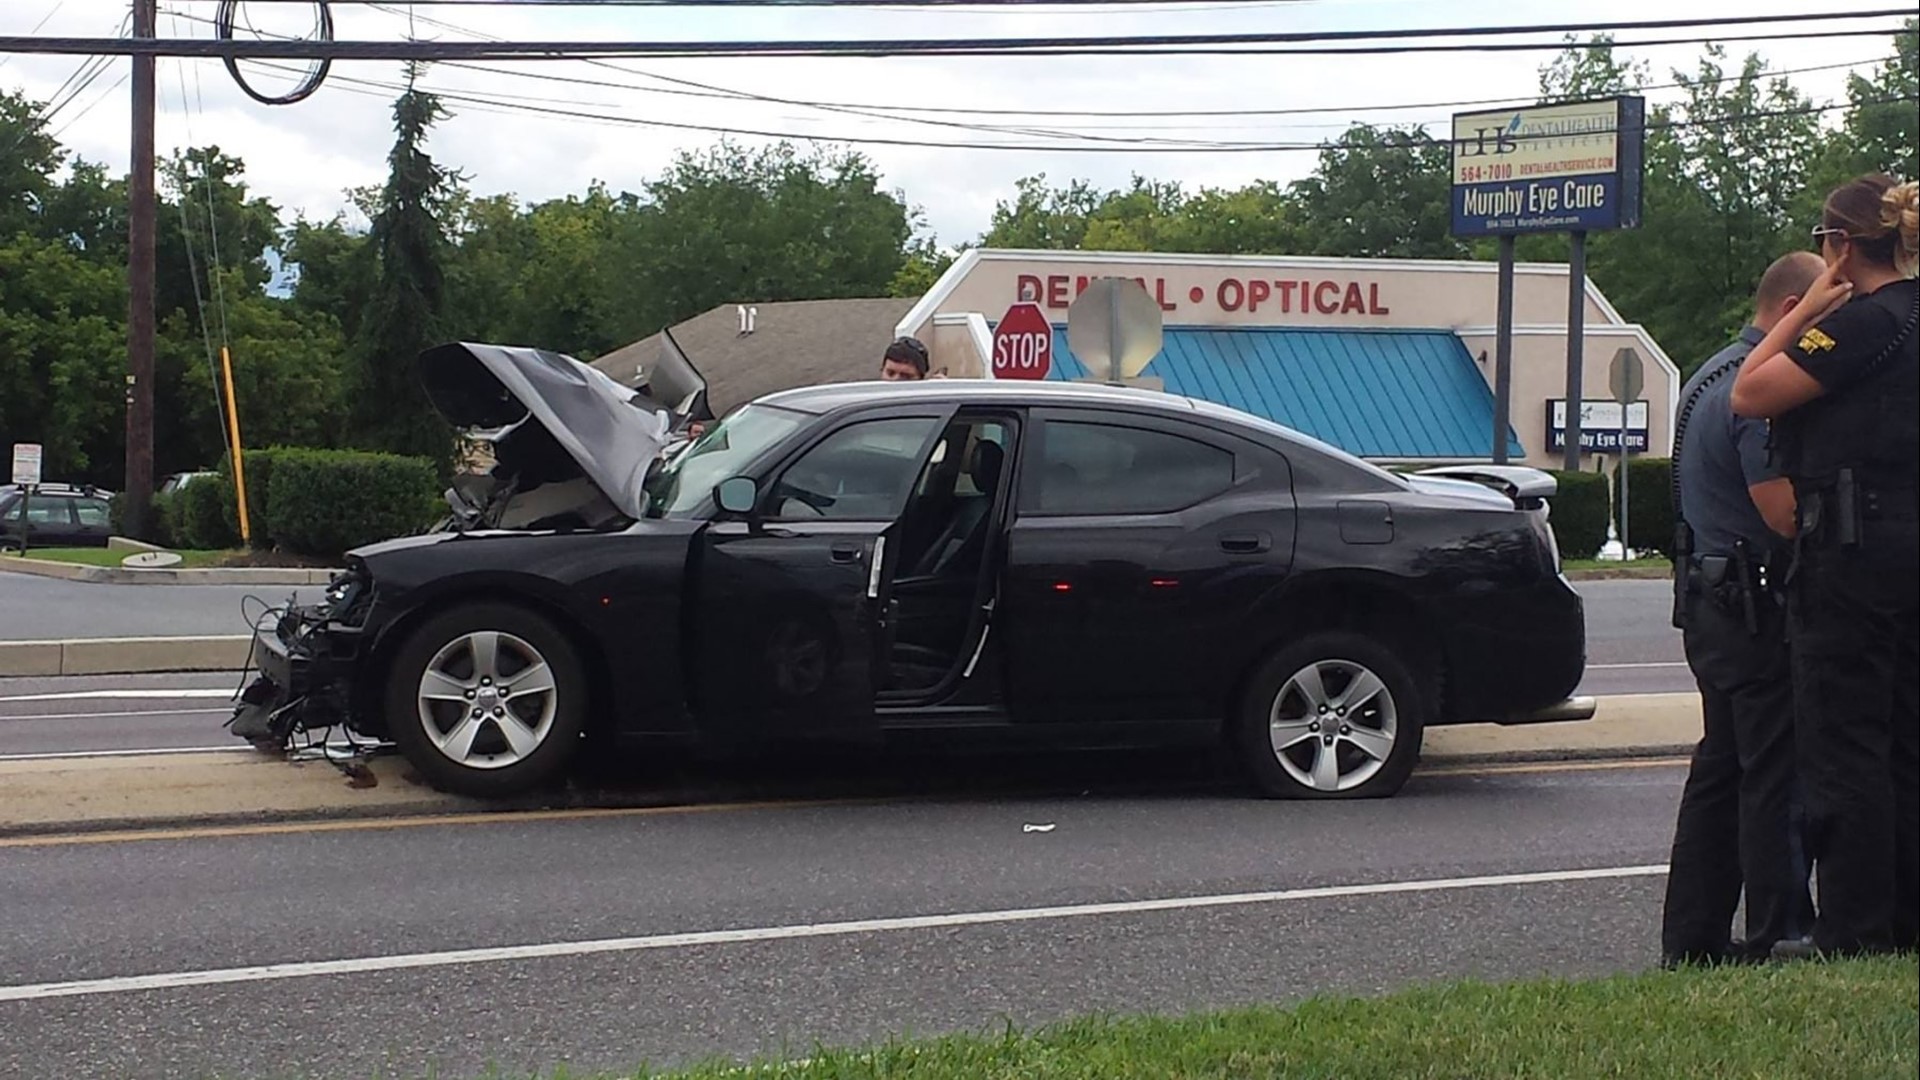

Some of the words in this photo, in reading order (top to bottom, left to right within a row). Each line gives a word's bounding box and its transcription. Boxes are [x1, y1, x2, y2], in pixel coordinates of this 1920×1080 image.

[1461, 163, 1512, 182] 564-7010
[1464, 186, 1524, 217] Murphy
[1529, 183, 1558, 214] Eye
[1564, 180, 1604, 210] Care
[1018, 274, 1177, 311] DEL
[1216, 278, 1390, 315] OPTICAL
[995, 332, 1048, 369] STOP
[1597, 433, 1616, 447] Eye
